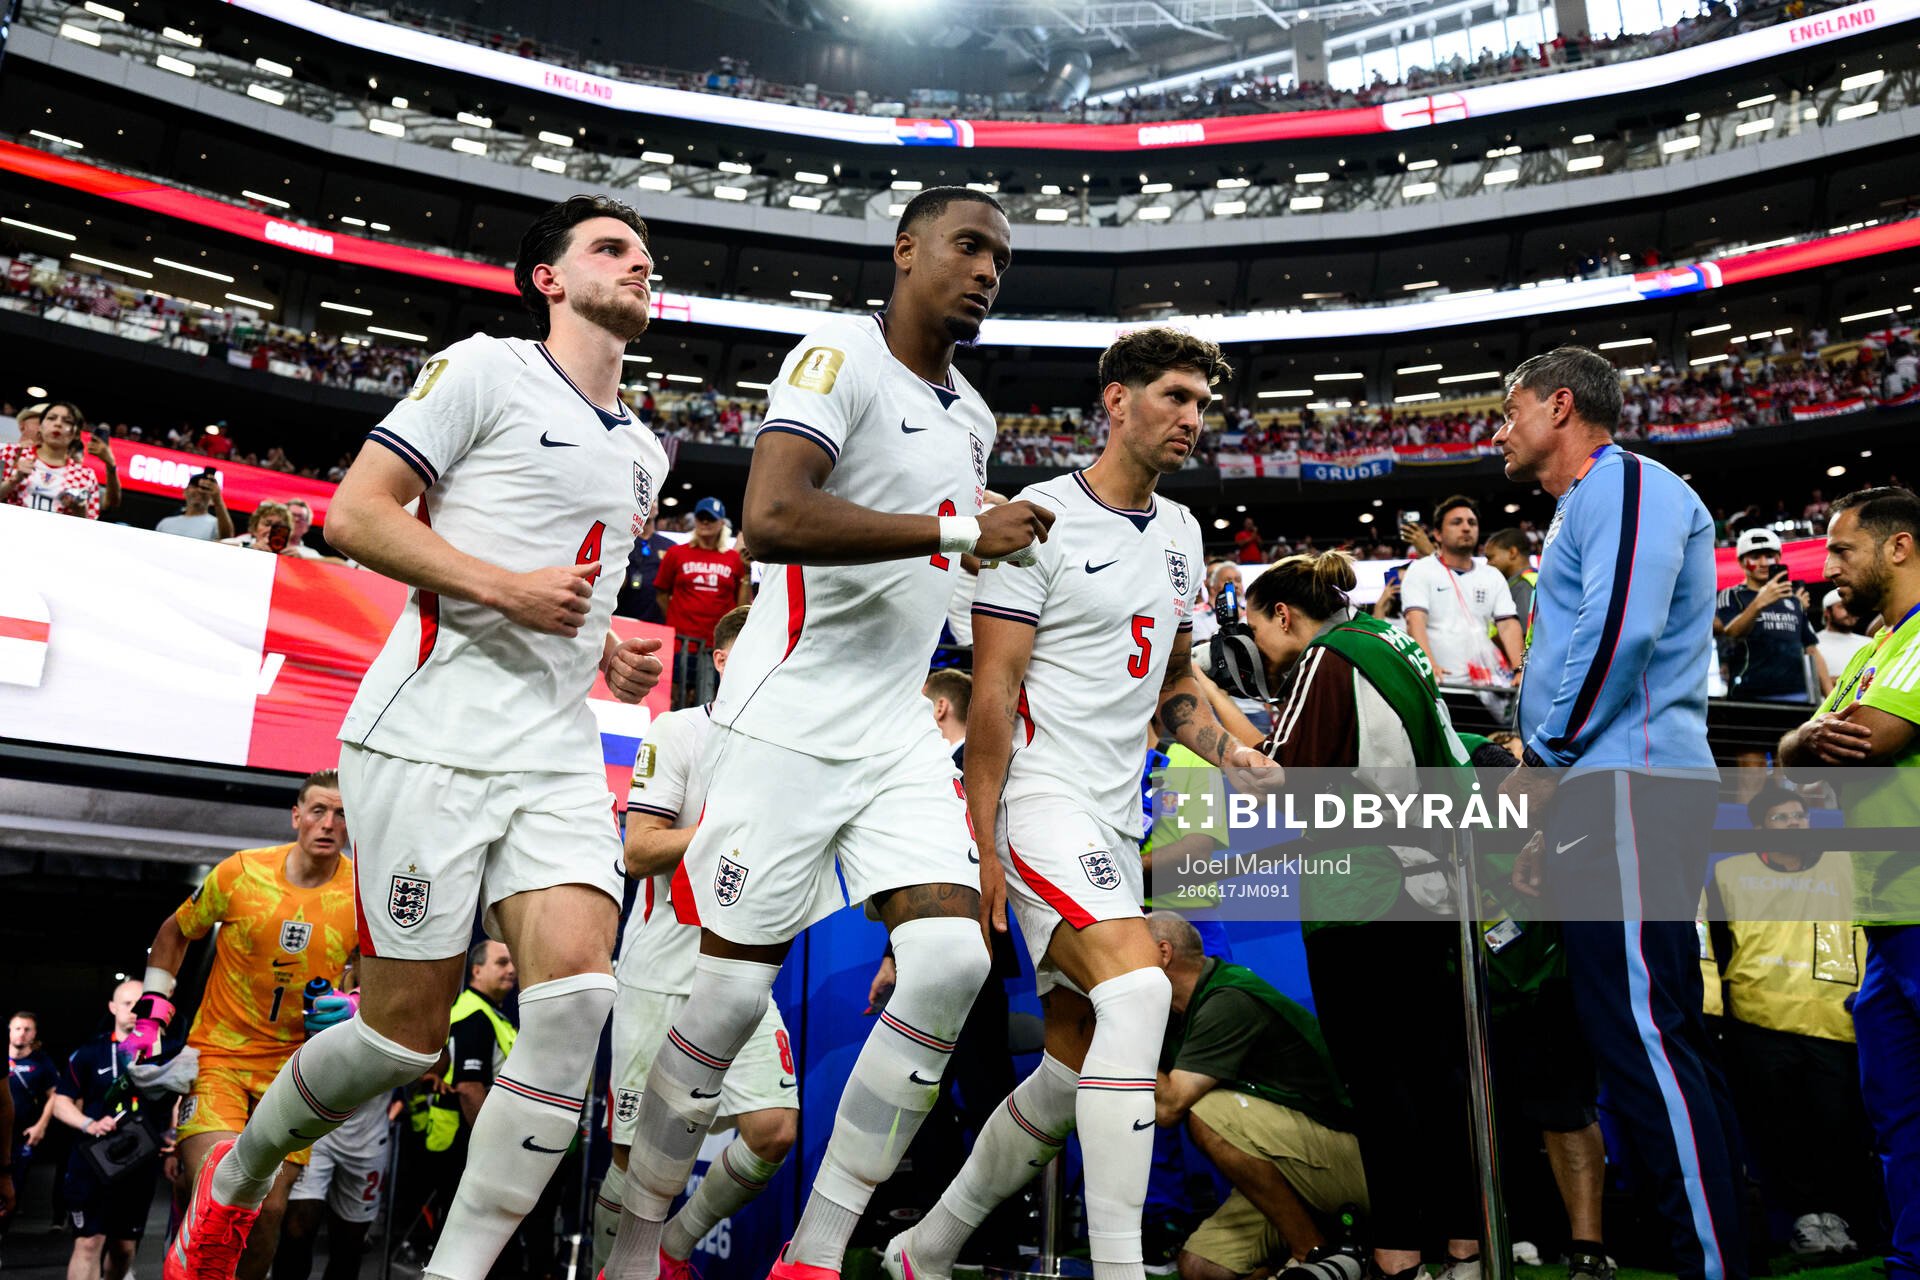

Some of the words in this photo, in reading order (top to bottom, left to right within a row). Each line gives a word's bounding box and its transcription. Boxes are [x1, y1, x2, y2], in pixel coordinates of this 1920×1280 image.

[1789, 8, 1875, 43] ENGLAND
[544, 71, 613, 100] ENGLAND
[1315, 462, 1383, 480] GRUDE
[575, 519, 606, 588] 4
[1127, 614, 1155, 679] 5
[1738, 875, 1840, 897] TECHNICAL
[269, 985, 284, 1022] 1
[775, 1029, 795, 1076] 8
